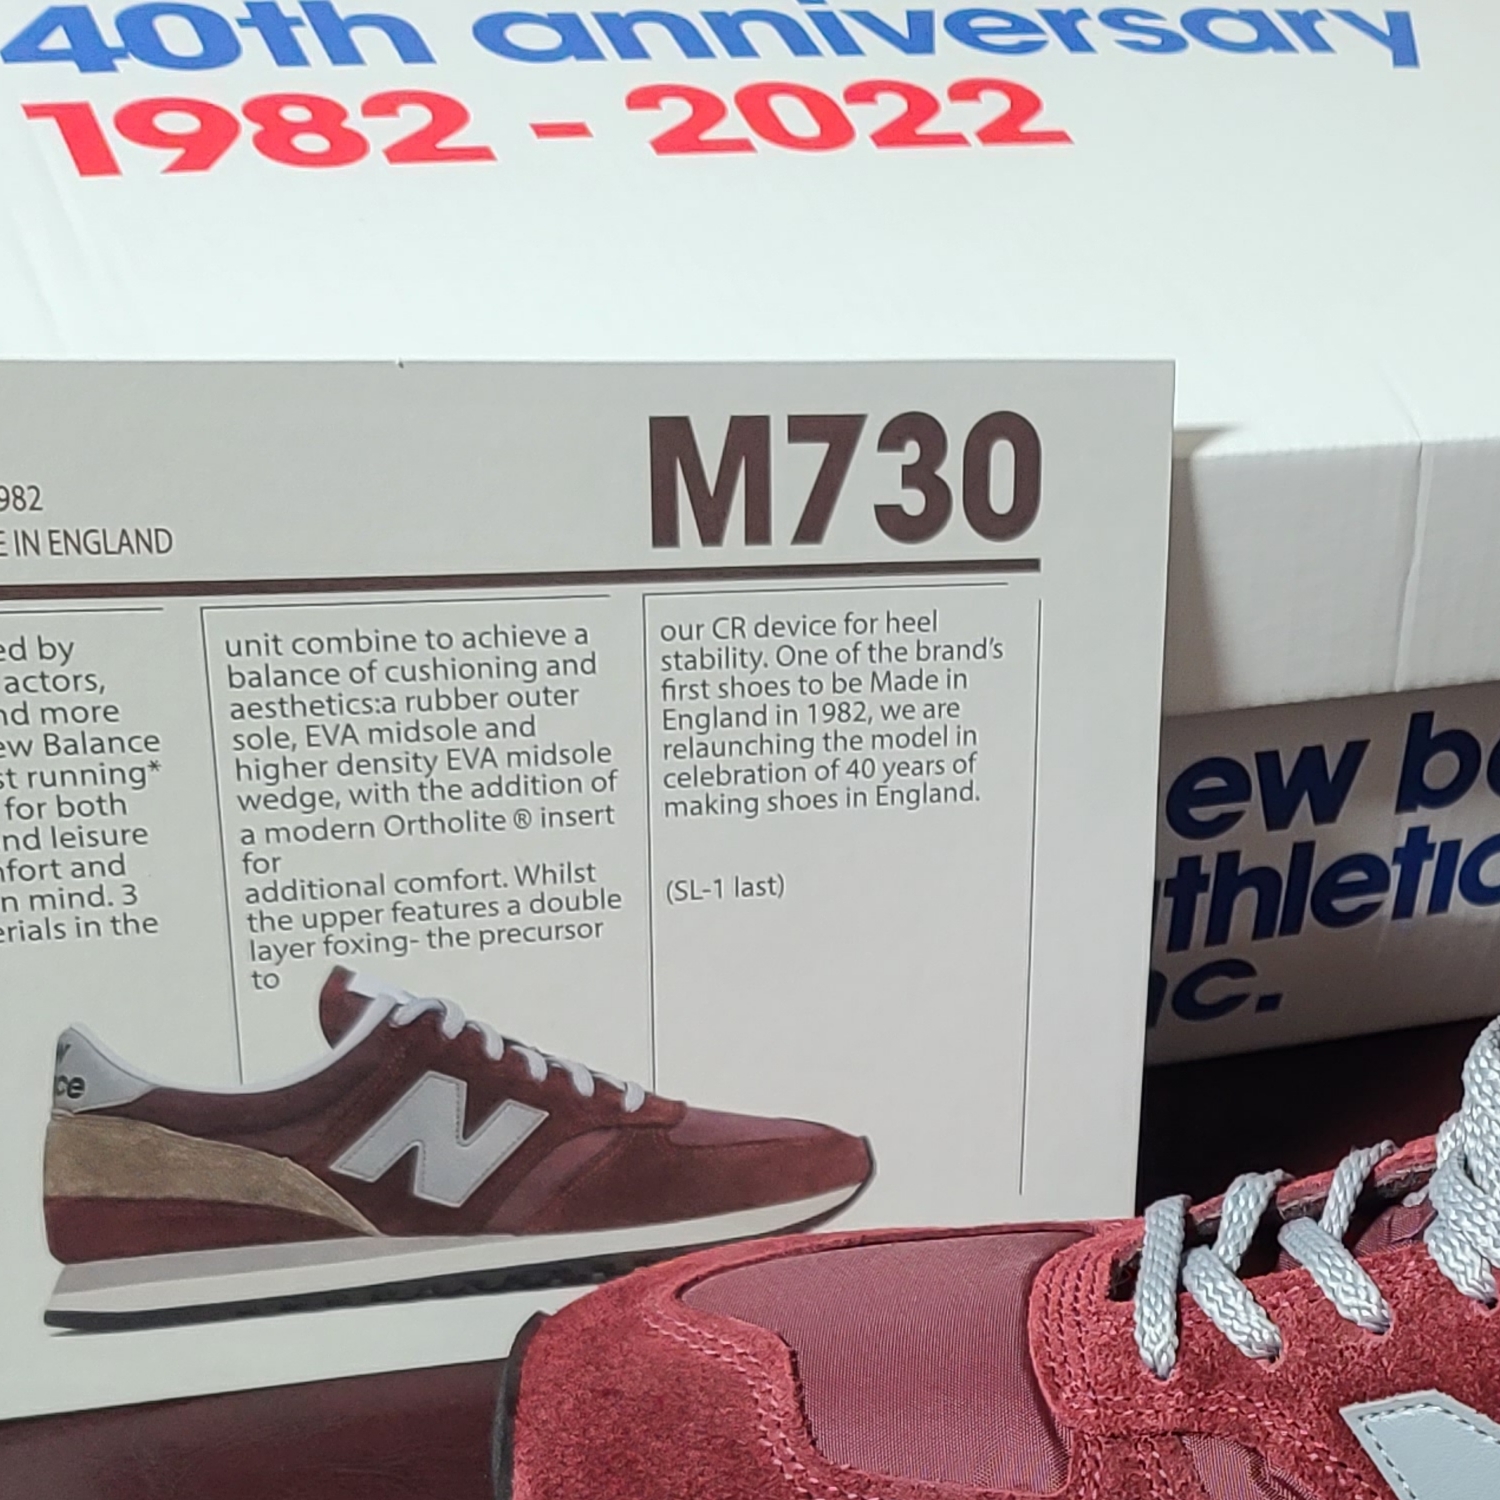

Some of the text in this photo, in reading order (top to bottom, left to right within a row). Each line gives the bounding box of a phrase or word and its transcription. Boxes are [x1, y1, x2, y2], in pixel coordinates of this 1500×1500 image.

[0, 0, 1421, 73] 40th anniversary
[20, 89, 498, 178] 1982
[625, 77, 1075, 155] 2022
[649, 410, 1042, 548] M730
[14, 529, 40, 556] IN
[48, 528, 172, 556] ENGLAND
[225, 624, 588, 657] unit combine to achieve a
[661, 609, 937, 642] our CR device for heel
[37, 635, 74, 666] by
[661, 646, 768, 675] stability.
[776, 644, 828, 667] One
[836, 641, 862, 664] of
[867, 640, 908, 663] the
[4, 671, 105, 695] actors,
[227, 651, 596, 689] balance of cushioning and
[661, 668, 967, 701] first shoes to be Made in
[40, 705, 119, 724] more
[406, 687, 499, 712] rubber
[507, 686, 579, 708] outer
[233, 714, 535, 752] sole, EVA midsole and
[663, 701, 960, 735] England in 1982, we are
[43, 730, 160, 756] Balance
[664, 724, 976, 763] relaunching the model in
[235, 741, 611, 786] higher density EVA midsole
[664, 751, 978, 788] celebration of 40 years of
[4, 792, 127, 820] for both
[237, 769, 618, 814] wedge, with the addition of
[665, 779, 980, 819] making shoes in England.
[1164, 738, 1371, 841] ew
[3, 825, 148, 852] nd leisure
[241, 829, 255, 845] a
[265, 817, 375, 844] modern
[384, 810, 506, 837] Ortholite
[541, 805, 614, 828] insert
[71, 852, 125, 878] and
[242, 851, 281, 875] for
[29, 884, 113, 911] mind.
[122, 884, 137, 905] 3
[245, 861, 596, 904] additional comfort. Whilst
[667, 874, 784, 905] (SL-1 last)
[75, 916, 101, 938] in
[110, 912, 158, 936] the
[247, 887, 621, 936] the upper features a double
[250, 922, 603, 966] layer foxing- the precursor
[251, 971, 279, 990] to
[1149, 958, 1284, 1029] c.
[329, 1070, 549, 1208] N
